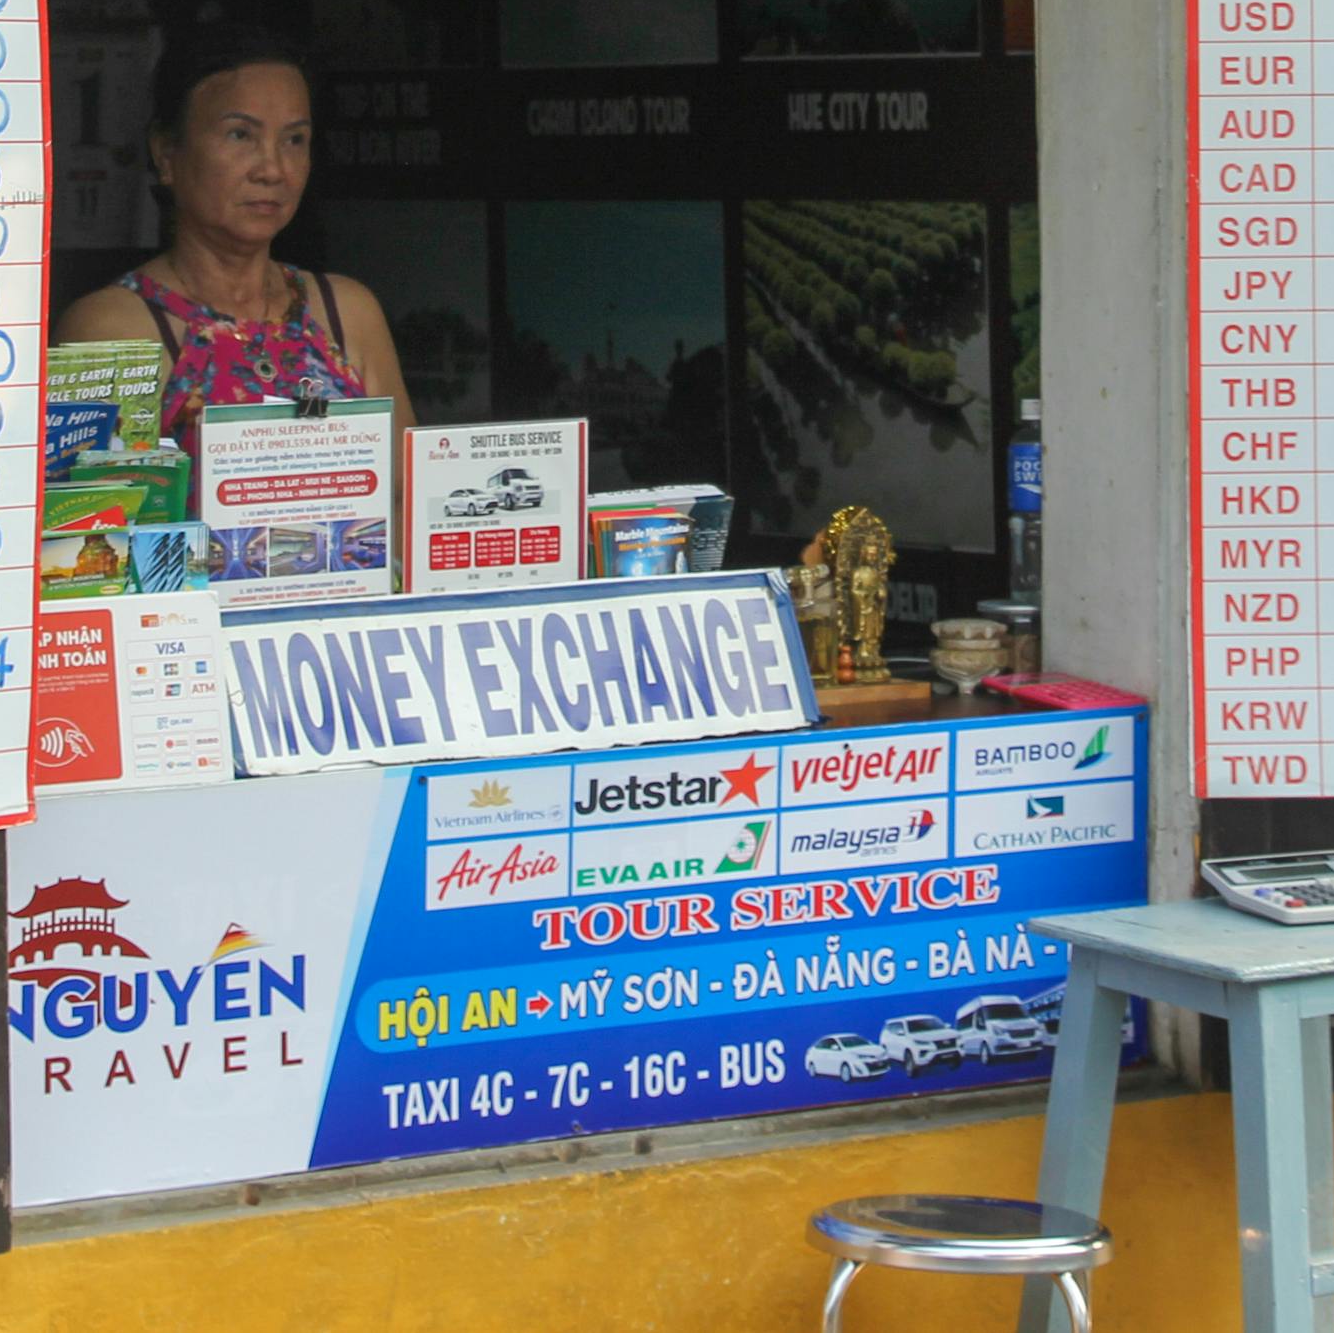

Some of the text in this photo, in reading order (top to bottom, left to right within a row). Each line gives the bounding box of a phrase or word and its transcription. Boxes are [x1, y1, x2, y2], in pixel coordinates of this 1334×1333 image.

[1219, 2, 1295, 32] USD
[1219, 56, 1295, 86] EUR
[786, 90, 930, 132] HUE CITY TOUR
[1219, 109, 1295, 139] AUD
[1219, 163, 1296, 193] CAD
[1218, 216, 1298, 247] SGD
[75, 381, 157, 400] TOURS TOURS
[278, 423, 326, 436] SLEEPING
[470, 431, 562, 448] SHUTTLE BUS SERVICE
[155, 642, 186, 655] VISA
[192, 683, 215, 694] ATM
[229, 596, 794, 758] MONEY EXCHANGE
[975, 740, 1076, 767] BAMBOO
[574, 771, 722, 816] Jetstar
[434, 807, 546, 830] Vietnam Airlines
[791, 826, 900, 854] malaysia
[576, 858, 704, 888] EVA AIR
[533, 864, 1000, 950] TOUR SERVICE
[378, 922, 1035, 1048] HỘI AN MỸ SƠN ĐÀ NẴNG BÀ NÀ
[44, 1030, 304, 1095] RAVEL
[382, 1039, 786, 1129] TAXI 4C 7C 16C BUS
